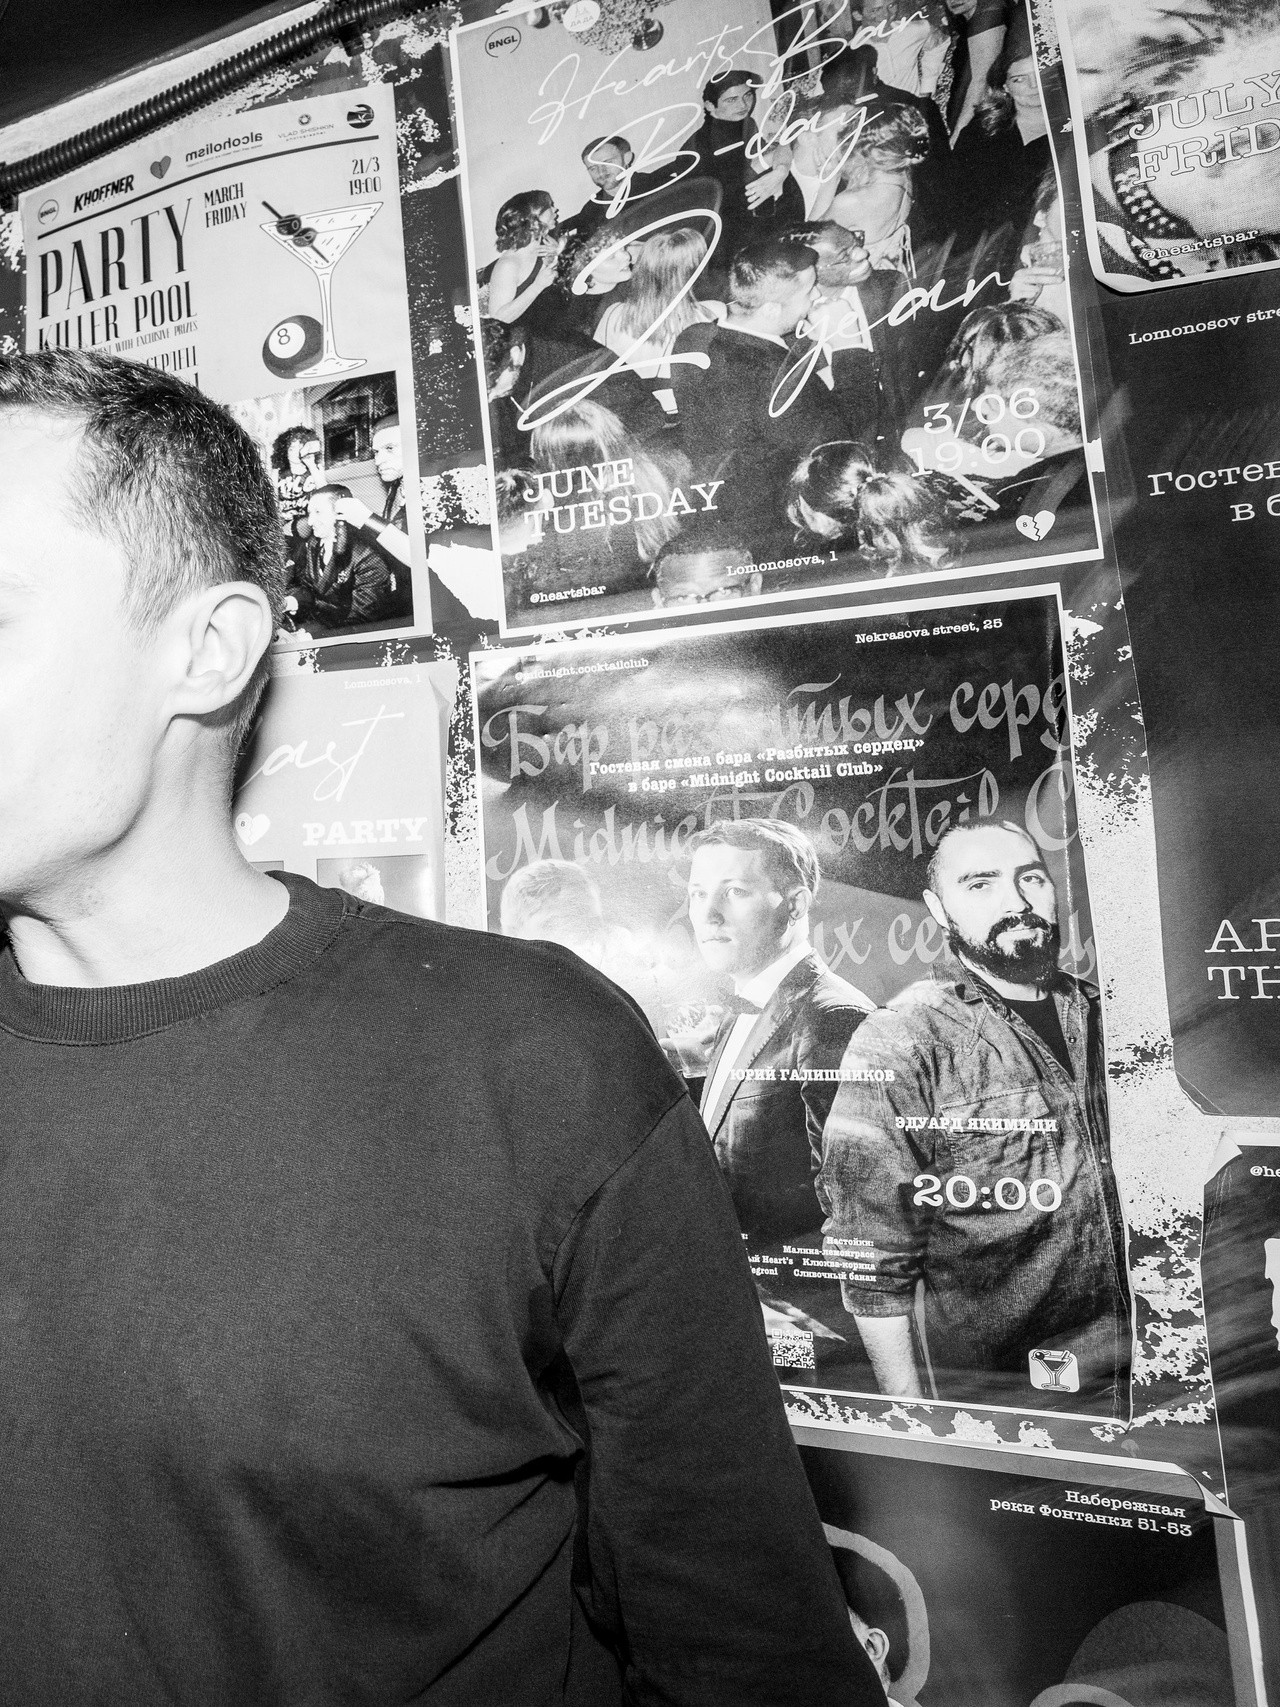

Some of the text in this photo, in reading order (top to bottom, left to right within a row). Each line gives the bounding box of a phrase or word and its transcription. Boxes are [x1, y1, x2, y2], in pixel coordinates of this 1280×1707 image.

[488, 35, 518, 50] BNGL
[352, 156, 380, 175] 21/3
[73, 174, 135, 213] KHOFFNER
[204, 182, 244, 209] MARCH
[349, 176, 381, 196] 19:00
[205, 201, 248, 228] FRIDAY
[38, 198, 193, 319] PARTY
[1140, 228, 1260, 261] @heartsbar
[38, 281, 198, 351] KILLER POOL
[1128, 315, 1242, 345] Lomonosov
[277, 327, 291, 346] 8
[921, 386, 1042, 440] 3/06
[909, 426, 1046, 479] 19:00
[522, 458, 636, 503] JUNE
[523, 480, 725, 538] TUESDAY
[1229, 502, 1256, 522] в
[725, 551, 839, 577] Lomonosova, 1
[529, 584, 607, 605] @heartsbar
[855, 618, 1003, 644] Nekrasova street, 25
[343, 677, 412, 690] Lomonosova,
[481, 704, 609, 794] Бар
[589, 737, 925, 775] Гостевая смена бара «Разбитых сердец»
[627, 760, 883, 794] в баре «Midnight Cocktail Club»
[302, 817, 428, 846] PARTY
[730, 1065, 896, 1082] ЮРИЙ ГАЛИШНИКОВ
[895, 1116, 1058, 1134] ЭДУАРД ЯКИМИДИ
[912, 1173, 1063, 1211] 20:00
[750, 1265, 779, 1276] egroni
[990, 1499, 1193, 1537] реки Фонтанки 51-53
[1065, 1490, 1186, 1518] Набережная
